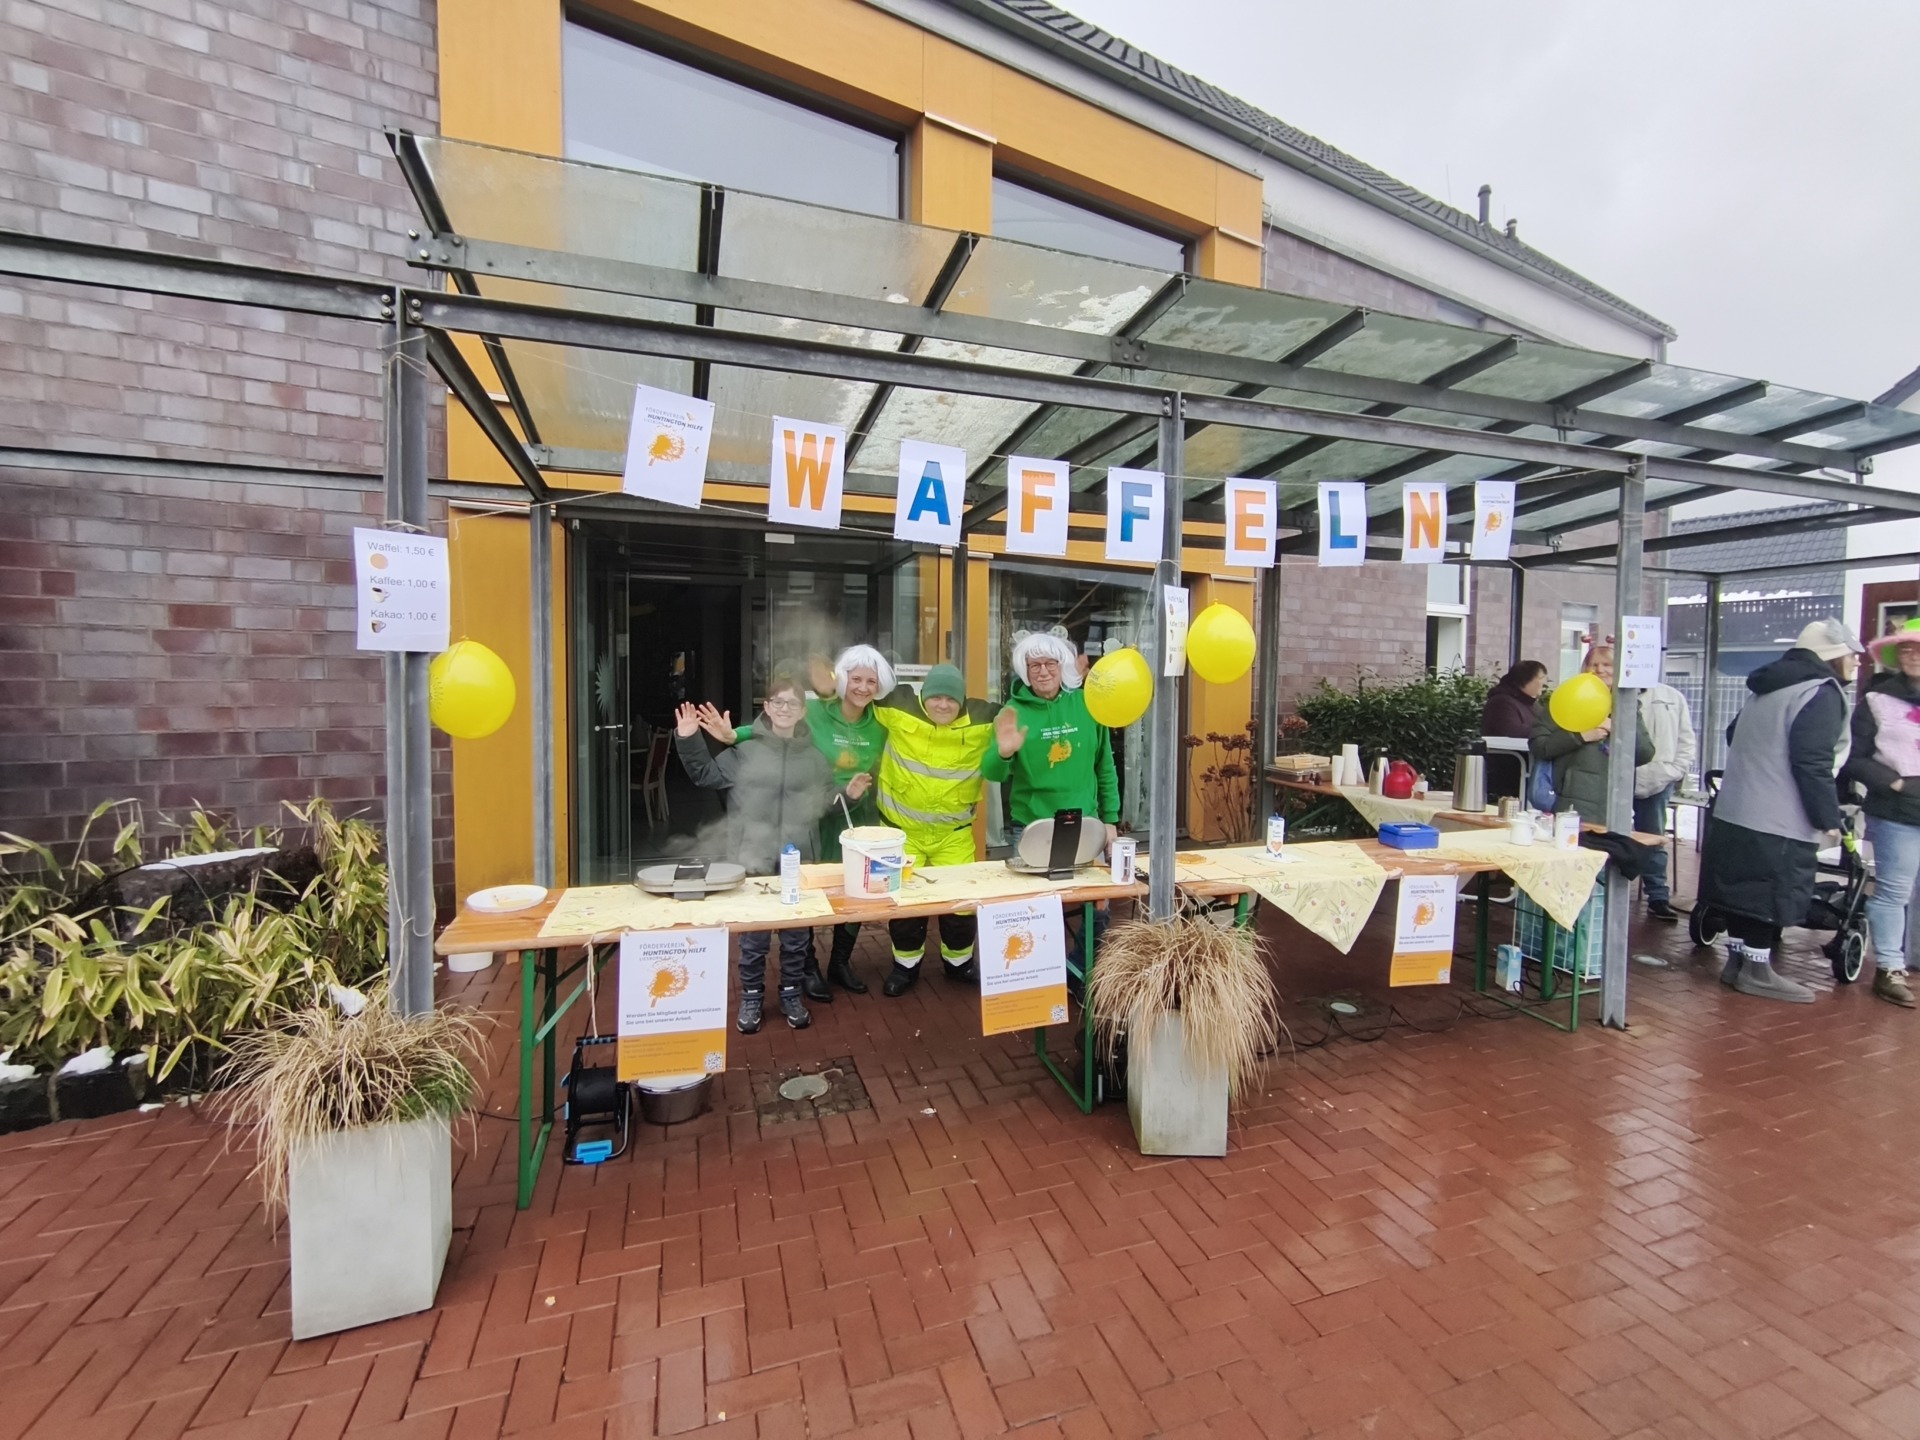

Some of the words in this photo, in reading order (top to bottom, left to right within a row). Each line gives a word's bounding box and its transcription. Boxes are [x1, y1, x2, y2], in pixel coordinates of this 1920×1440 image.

[648, 414, 686, 427] HUNTINGTON
[784, 430, 1440, 551] WAFFELN
[367, 542, 402, 553] Waffel:
[405, 546, 426, 556] 1,50
[428, 548, 435, 557] €
[370, 576, 405, 586] Kaffee:
[408, 579, 428, 588] 1,00
[430, 580, 437, 589] €
[370, 609, 405, 620] Kakao:
[408, 612, 428, 621] 1,00
[431, 613, 437, 621] €
[996, 916, 1030, 925] HUNTINGTON
[640, 942, 685, 950] FÖRDERVEREIN
